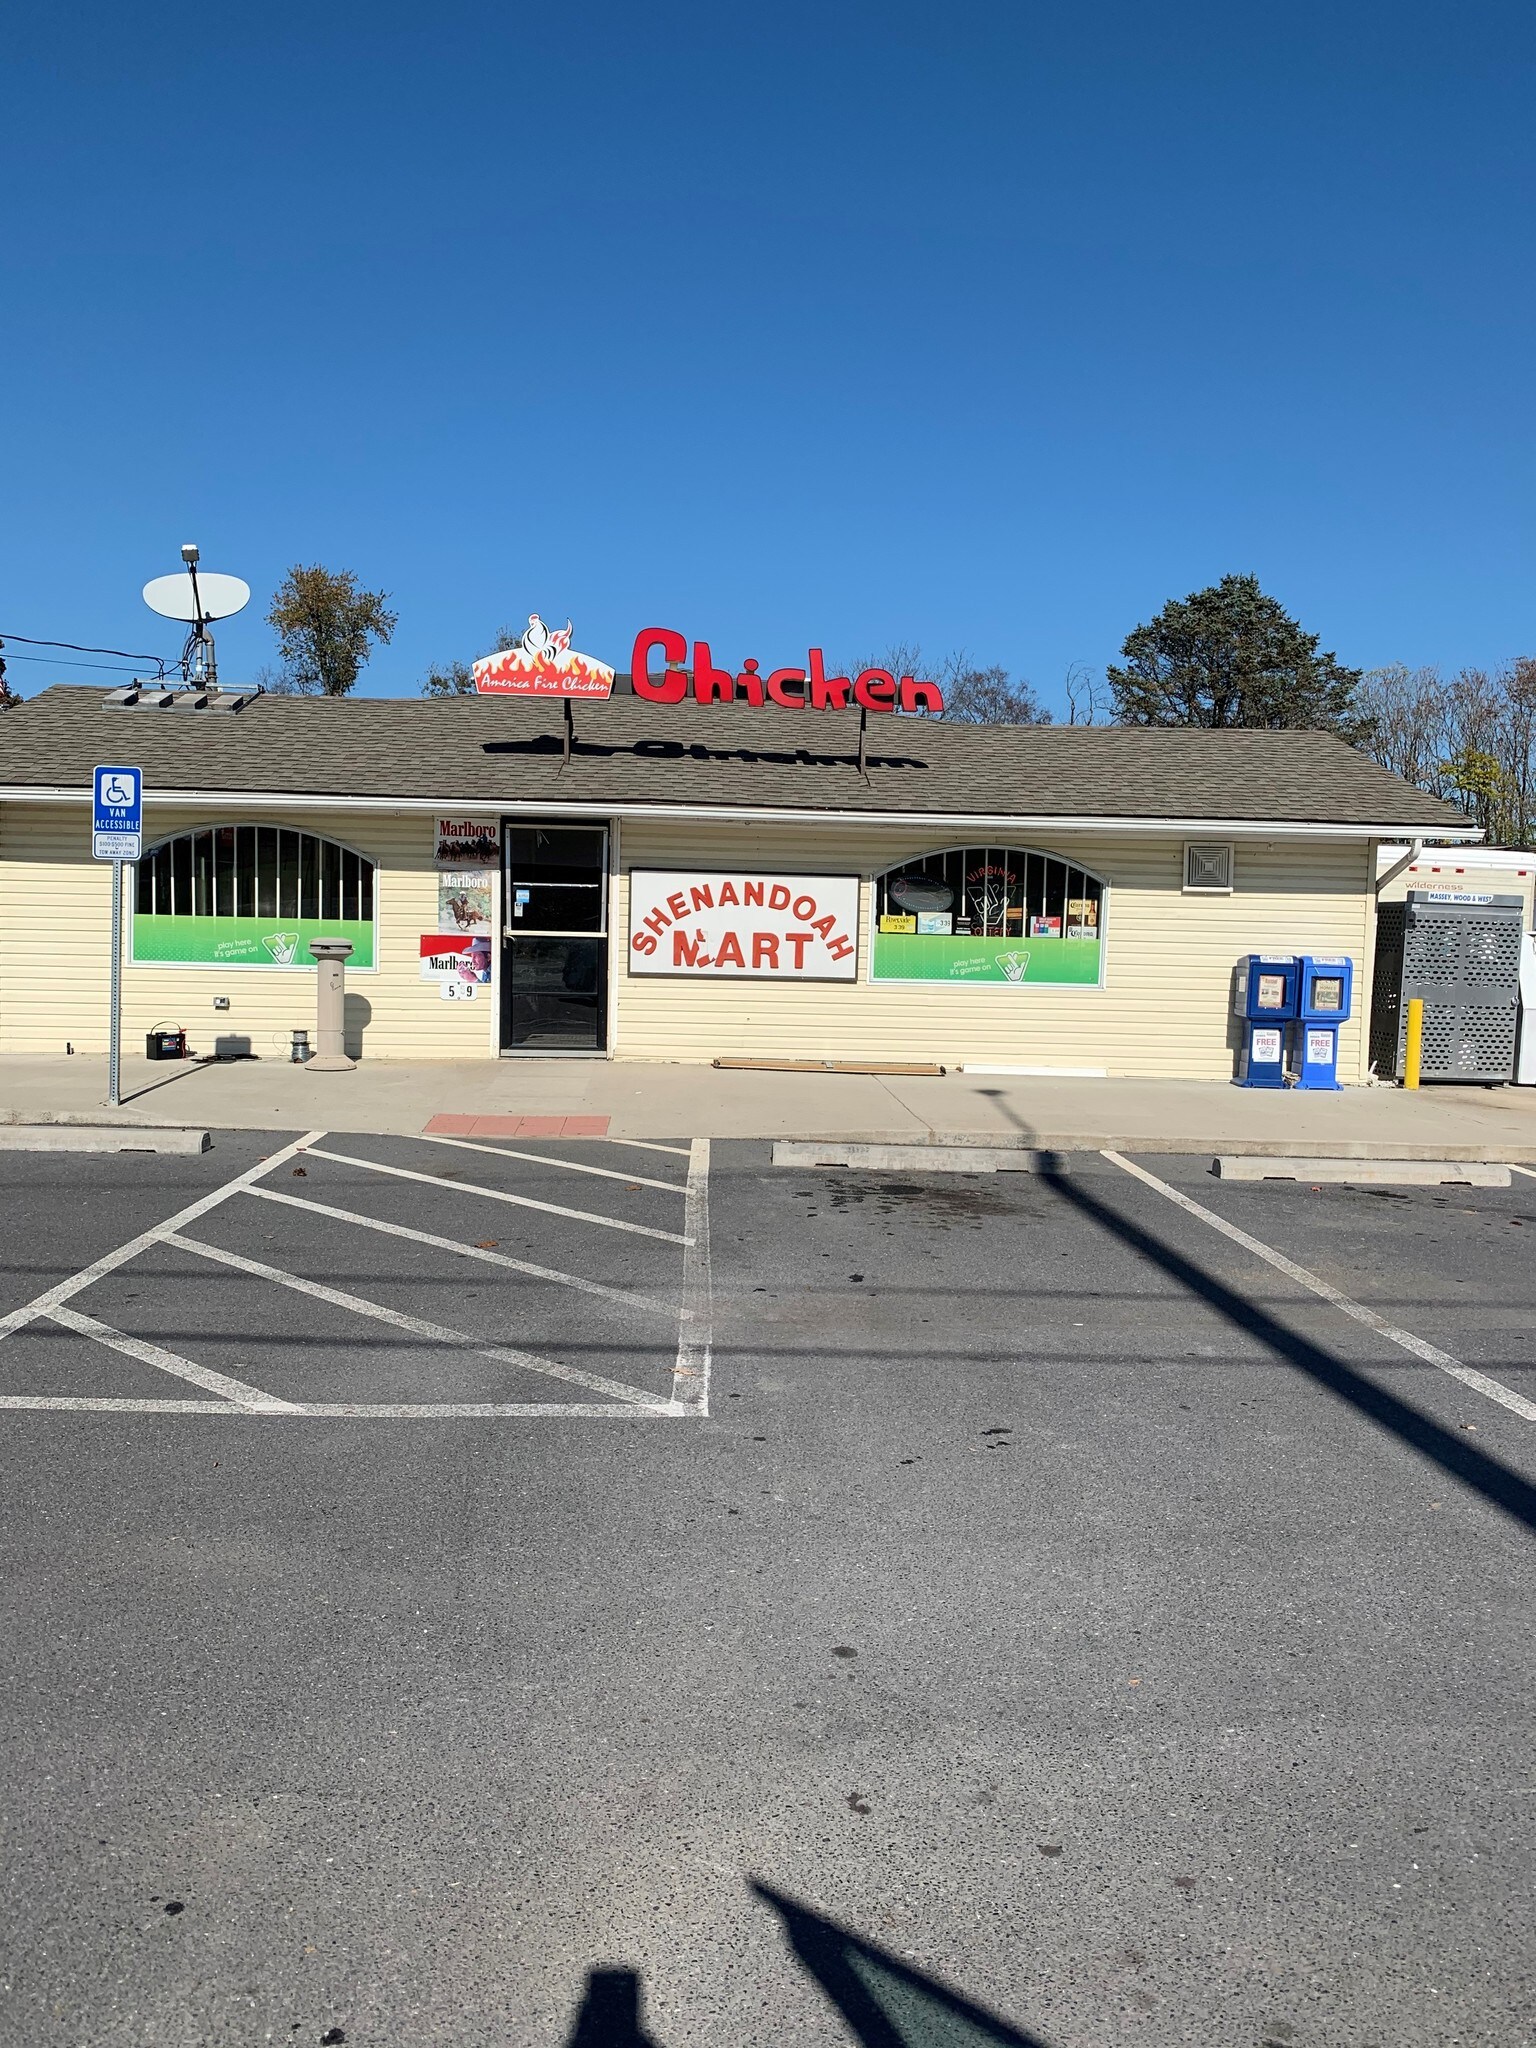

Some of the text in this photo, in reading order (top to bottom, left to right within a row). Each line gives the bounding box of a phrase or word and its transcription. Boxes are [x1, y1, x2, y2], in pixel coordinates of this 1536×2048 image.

[631, 627, 944, 712] Chicken
[481, 672, 609, 691] America Fire Chicken
[109, 808, 126, 818] VAN
[95, 819, 140, 830] ACCESSIBLE
[440, 820, 496, 838] Marlboro
[442, 874, 488, 888] Marlboro
[1405, 881, 1464, 891] wilderness
[1430, 892, 1452, 901] MASSEY,
[1453, 894, 1471, 902] WOOD
[632, 881, 855, 961] SHENANDOAH
[218, 939, 252, 951] play here
[673, 928, 814, 969] MART
[225, 948, 247, 959] game
[953, 957, 986, 969] play here
[959, 965, 981, 976] game
[1256, 1038, 1277, 1046] FREE
[1310, 1039, 1331, 1047] FREE
